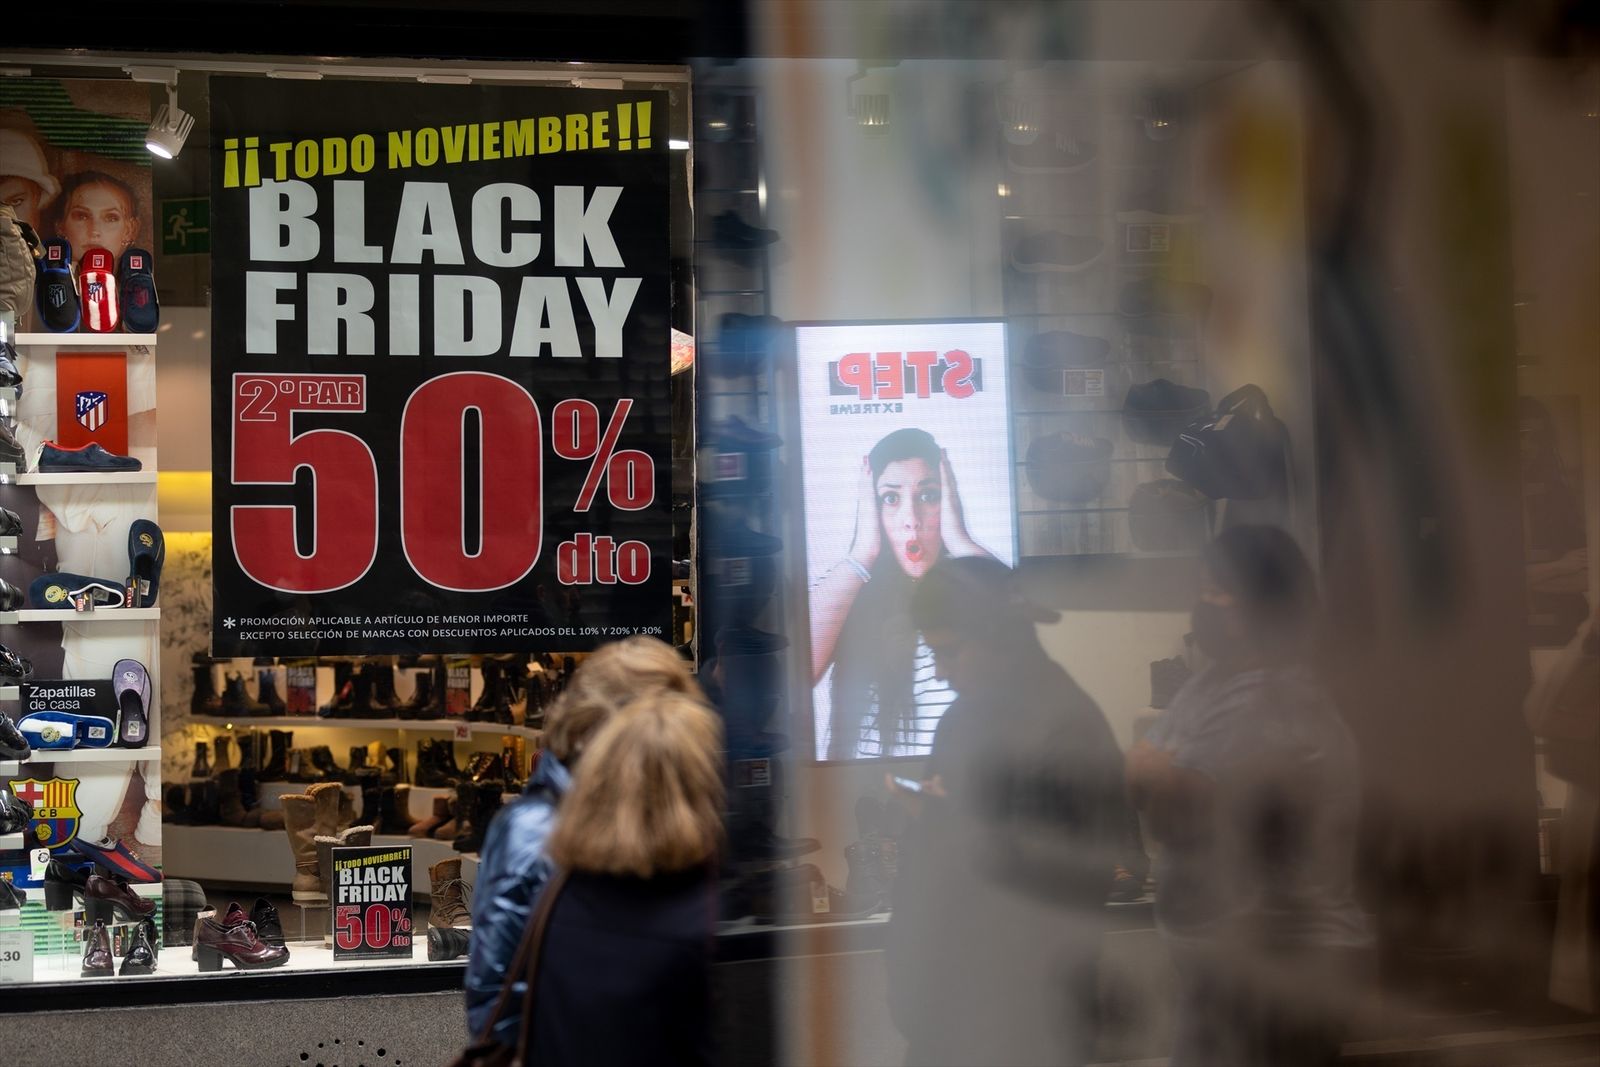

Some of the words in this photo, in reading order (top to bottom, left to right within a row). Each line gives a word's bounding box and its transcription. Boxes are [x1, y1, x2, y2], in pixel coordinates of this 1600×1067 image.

[388, 101, 651, 169] NOVIEMBRE!!
[249, 178, 626, 268] BLACK
[246, 271, 643, 358] FRIDAY
[299, 381, 361, 404] PAR
[556, 533, 652, 585] dto
[240, 615, 305, 626] PROMOCIÓN
[308, 616, 362, 625] APLICABLE
[364, 616, 372, 625] A
[374, 614, 424, 624] ARTÍCULO
[426, 615, 440, 624] DE
[442, 615, 481, 623] MENOR
[483, 614, 529, 623] IMPORTE
[240, 631, 285, 640] EXCEPTO
[287, 629, 343, 639] SELECCIÓN
[346, 630, 359, 639] DE
[362, 629, 405, 638] MARCAS
[407, 629, 429, 638] CON
[432, 628, 498, 637] DESCUENTOS
[500, 627, 556, 637] APLICADOS
[558, 627, 577, 636] DEL
[580, 626, 599, 636] 10%
[601, 626, 608, 635] Y
[610, 626, 631, 635] 20%
[633, 626, 639, 634] Y
[641, 626, 662, 635] 30%
[29, 686, 96, 700] Zapatillas
[29, 699, 46, 710] de
[50, 700, 80, 710] casa
[339, 866, 405, 885] BLACK
[338, 884, 408, 903] FRIDAY
